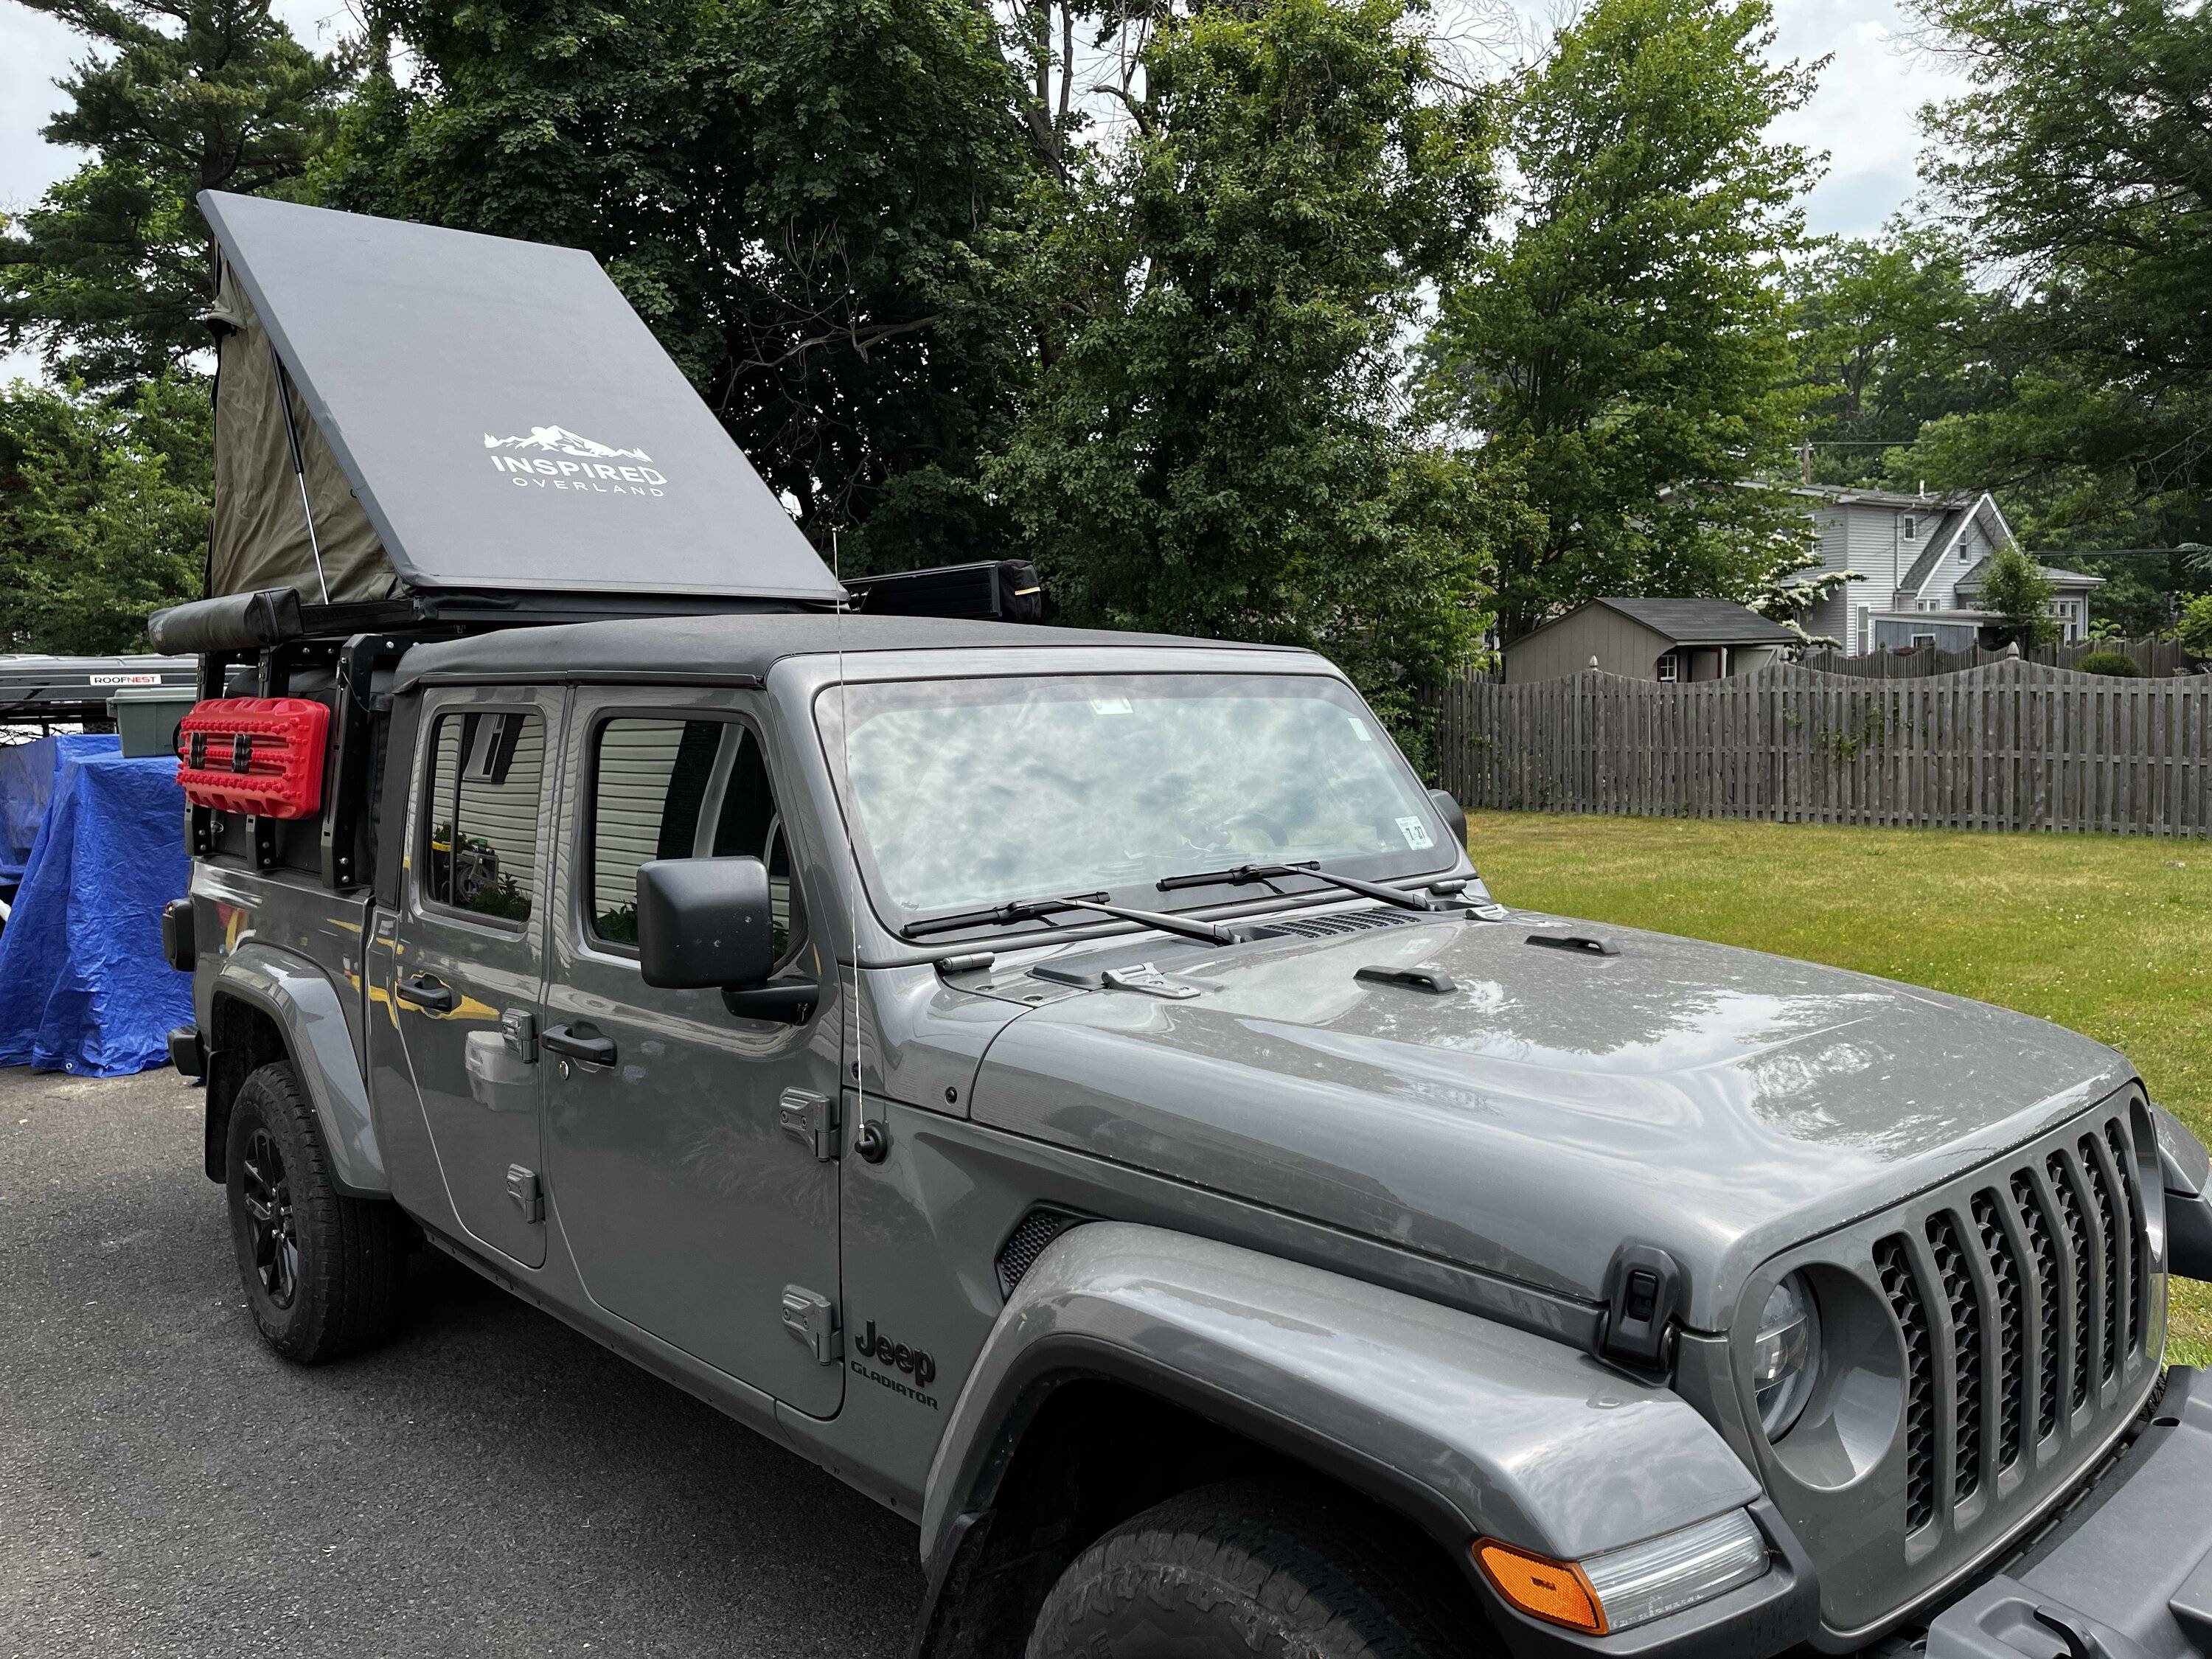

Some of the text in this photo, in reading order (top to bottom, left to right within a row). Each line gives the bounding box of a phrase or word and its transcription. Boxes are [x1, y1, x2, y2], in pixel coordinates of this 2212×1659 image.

[491, 455, 667, 485] INSPIRED
[512, 477, 664, 497] OVERLAND
[94, 675, 156, 684] ROOFNEST
[855, 1318, 936, 1388] Jeep
[851, 1360, 939, 1411] GLADIATOR
